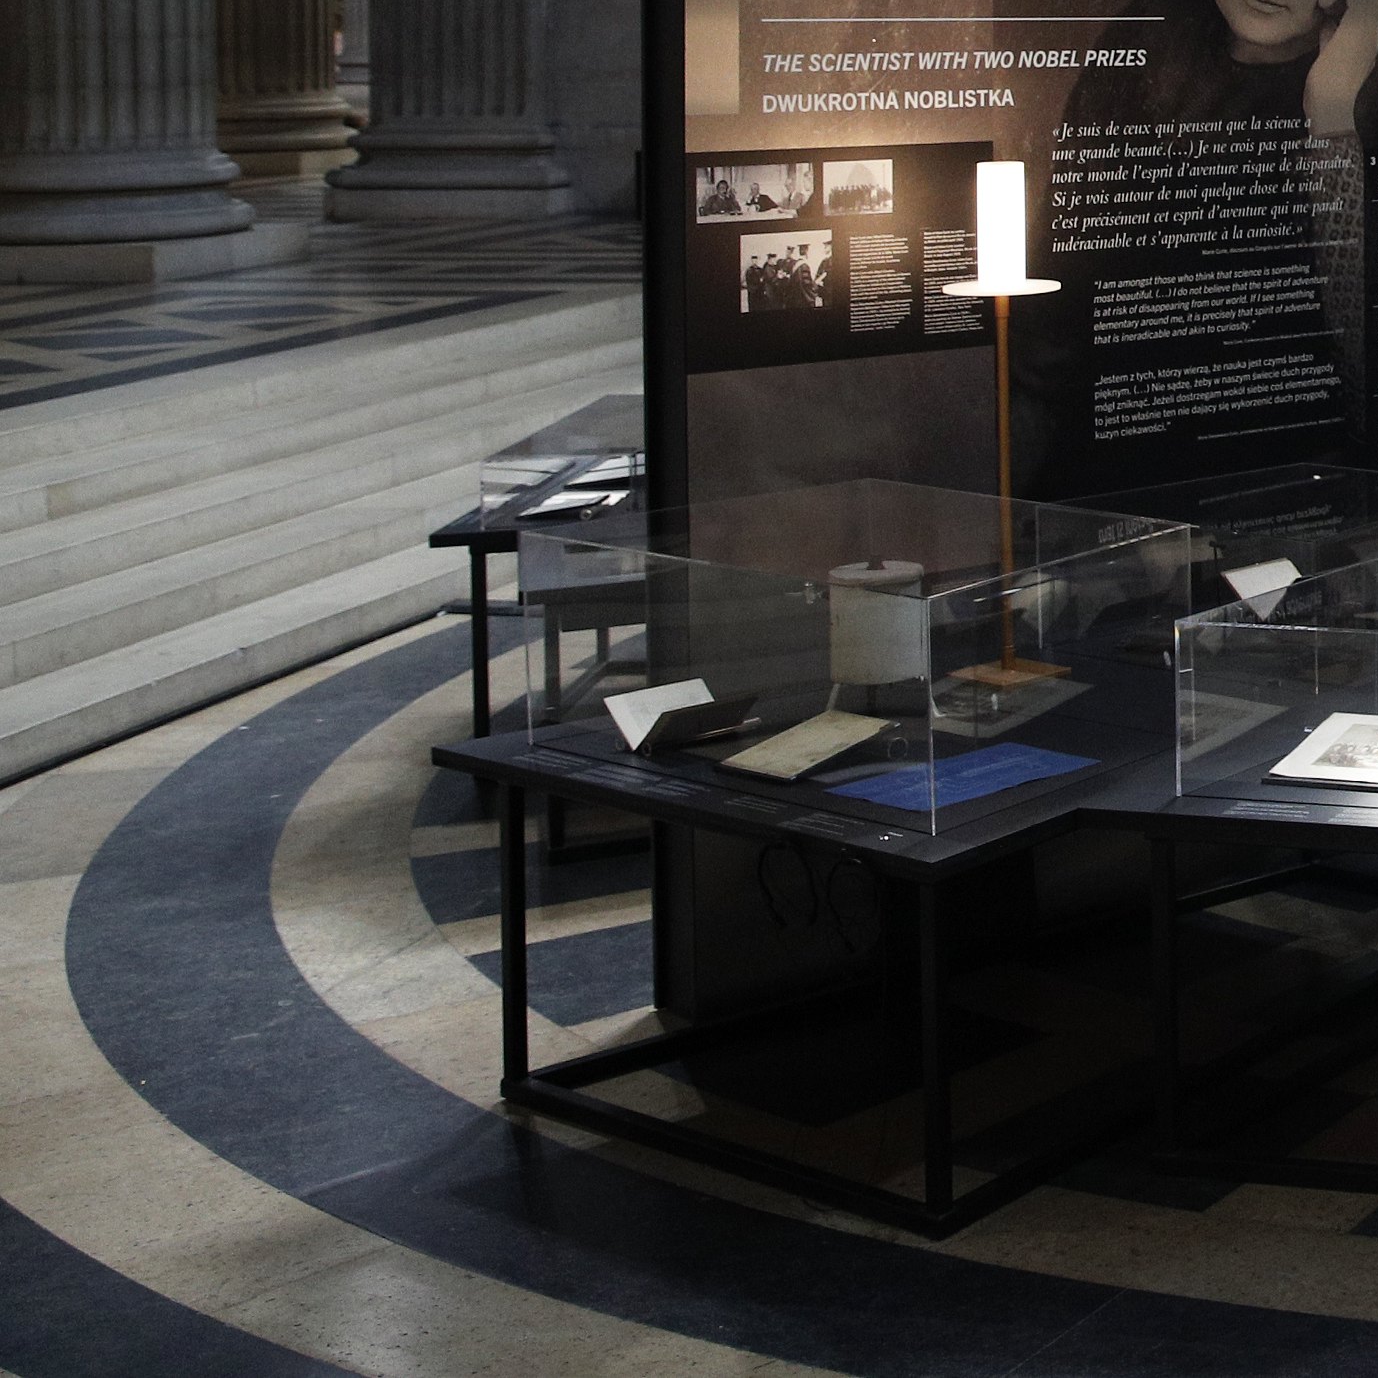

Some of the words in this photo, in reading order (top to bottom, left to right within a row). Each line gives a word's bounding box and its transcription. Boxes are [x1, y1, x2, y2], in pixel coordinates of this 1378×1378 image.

[762, 53, 804, 74] THE
[808, 52, 915, 73] SCIENTIST
[918, 51, 969, 71] WITH
[972, 50, 1015, 70] TWO
[1018, 50, 1080, 69] NOBEL
[1083, 48, 1148, 67] PRIZES
[762, 91, 899, 113] DWUKROTNA
[904, 88, 1015, 110] NOBLISTKA
[1076, 121, 1101, 137] suis
[1105, 120, 1120, 136] de
[1122, 124, 1151, 135] ceux
[1155, 118, 1175, 137] qui
[1176, 119, 1223, 138] pensent
[1225, 120, 1247, 136] que
[1250, 115, 1261, 130] la
[1264, 115, 1301, 130] science
[1304, 118, 1312, 128] a
[1052, 150, 1075, 160] une
[1076, 142, 1120, 164] grande
[1193, 139, 1209, 159] Je
[1212, 143, 1227, 153] ne
[1229, 138, 1255, 153] crois
[1257, 140, 1277, 156] pas
[1280, 139, 1301, 155] que
[1304, 134, 1330, 149] dans
[1370, 156, 1376, 166] 3
[1051, 170, 1084, 184] notre
[1087, 164, 1129, 182] monde
[1242, 159, 1276, 177] risque
[1278, 156, 1292, 172] de
[1051, 191, 1067, 207] Si
[1066, 190, 1082, 211] je
[1085, 189, 1110, 204] vois
[1113, 190, 1154, 203] autour
[1157, 184, 1171, 200] de
[1174, 184, 1198, 199] moi
[1201, 181, 1246, 202] quelque
[1248, 179, 1279, 195] chose
[1281, 178, 1295, 193] de
[1153, 210, 1169, 223] cet
[1172, 206, 1204, 226] esprit
[1270, 200, 1289, 220] qui
[1292, 203, 1309, 214] me
[1311, 196, 1343, 217] paraît
[1135, 234, 1147, 247] et
[1221, 226, 1228, 240] à
[1232, 224, 1243, 239] la
